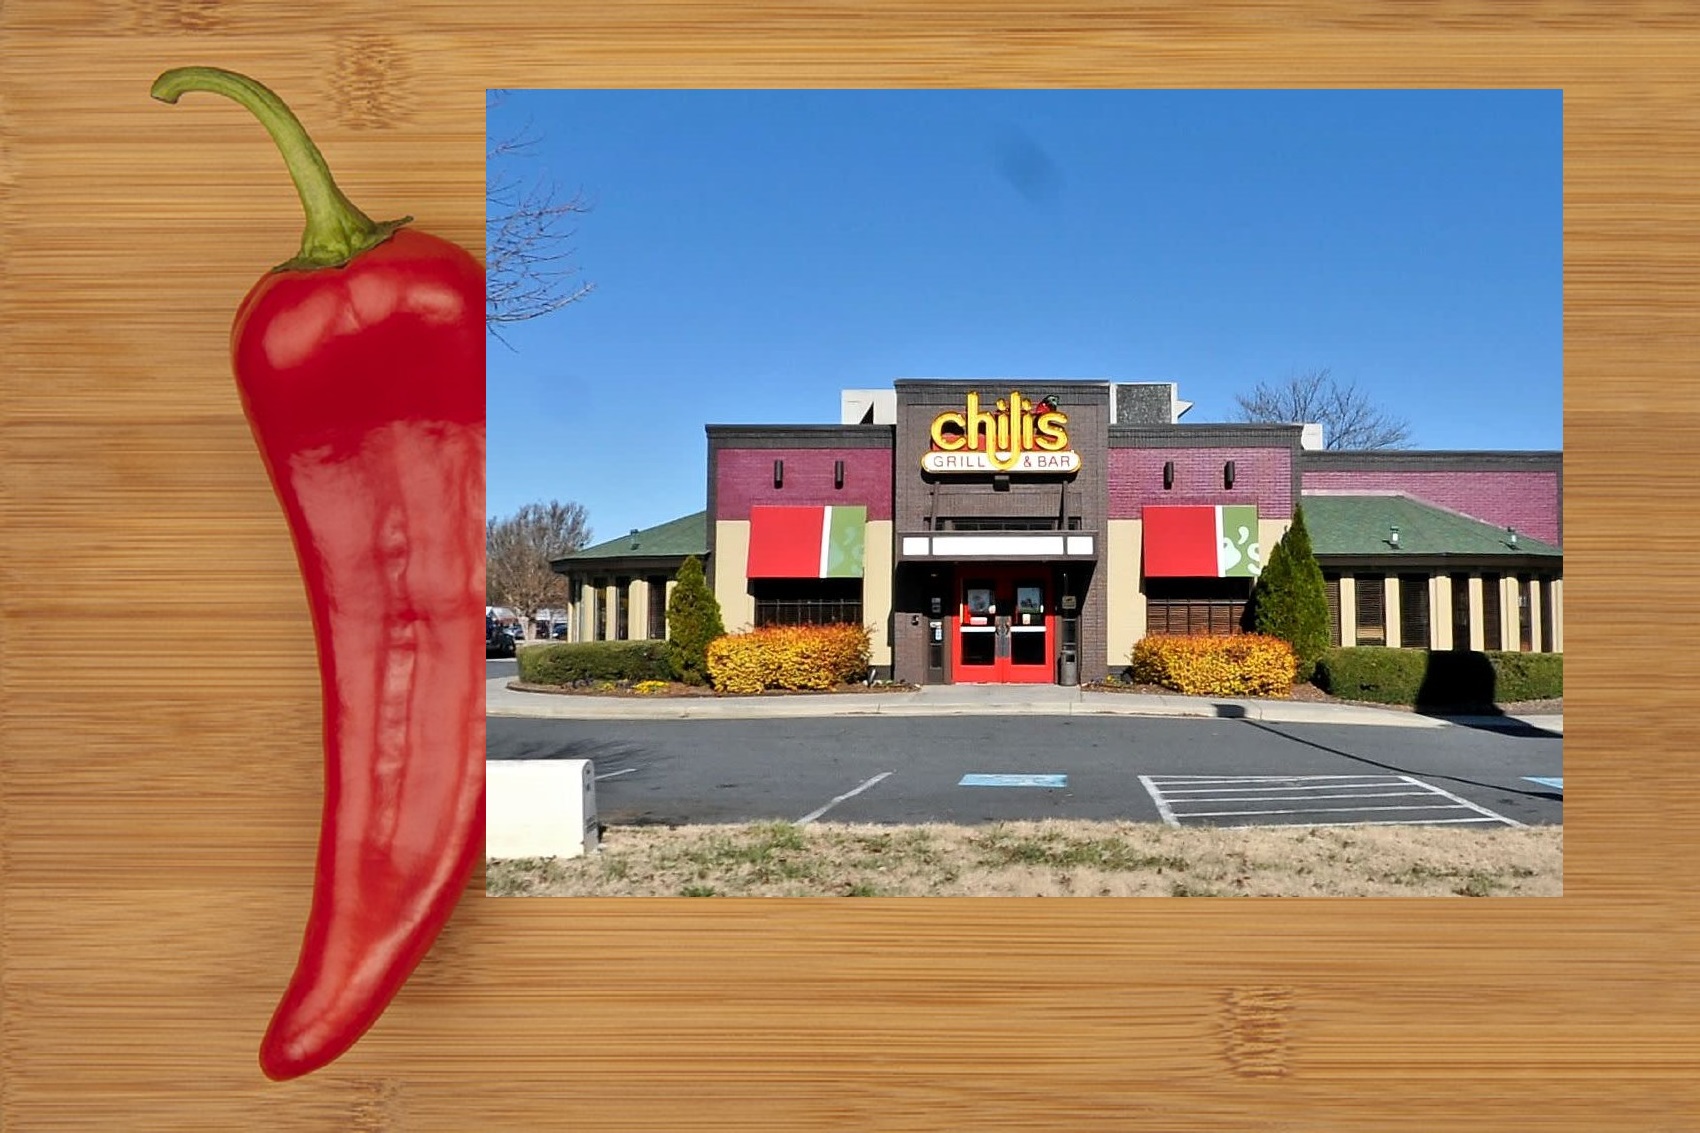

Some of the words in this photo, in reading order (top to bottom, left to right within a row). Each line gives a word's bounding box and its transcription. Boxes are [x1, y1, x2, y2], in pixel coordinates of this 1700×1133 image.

[933, 455, 986, 468] GRILL
[1023, 455, 1033, 468] &
[1037, 455, 1071, 468] BAR
